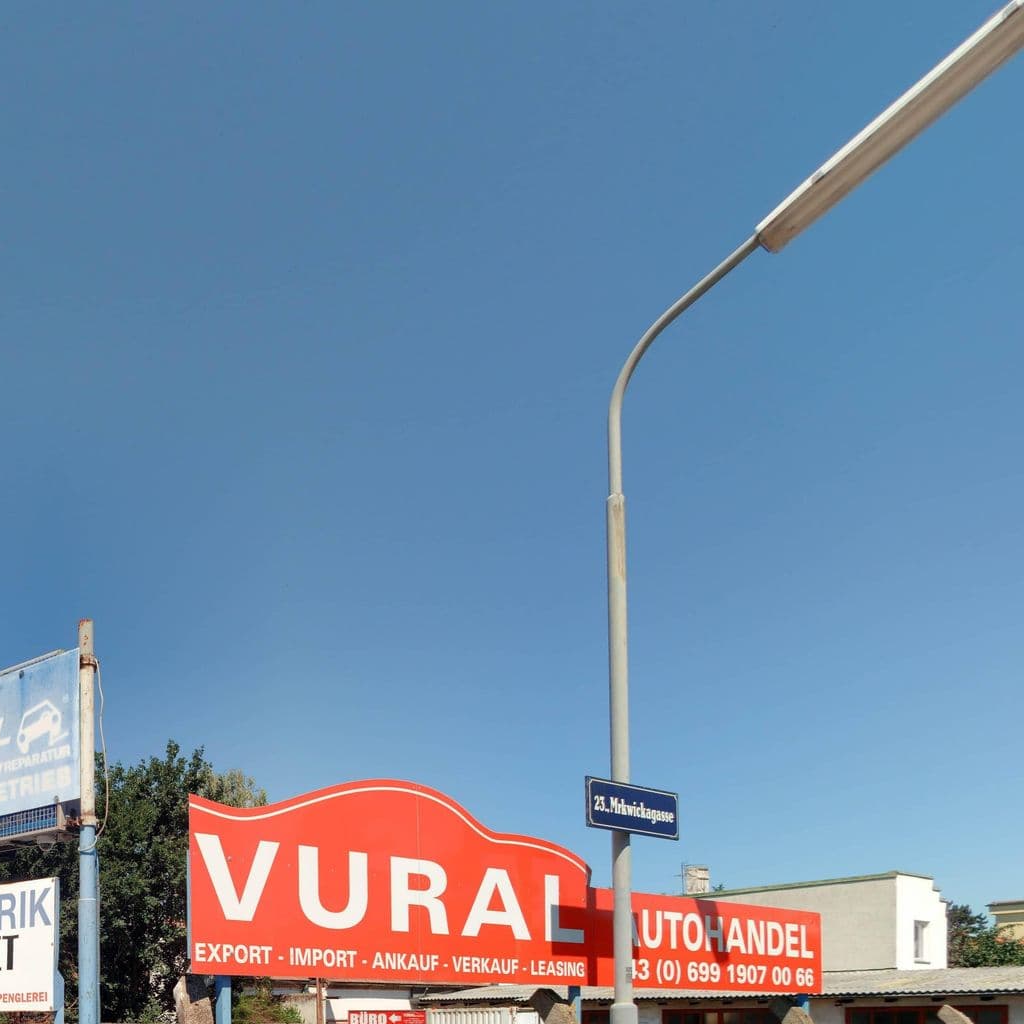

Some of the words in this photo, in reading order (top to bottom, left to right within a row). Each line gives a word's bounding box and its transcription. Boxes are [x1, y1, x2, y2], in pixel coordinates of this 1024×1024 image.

[2, 745, 71, 772] REPARATUR
[610, 797, 674, 825] Mrkwickagasse
[194, 833, 585, 944] VURAL
[195, 942, 272, 964] EXPORT
[289, 946, 357, 969] IMPORT
[372, 952, 439, 972] ANKAUF
[452, 956, 519, 974] VERKAUF
[530, 960, 585, 978] LEASING
[656, 959, 681, 984] (0)
[687, 962, 720, 982] 699
[727, 963, 766, 984] 1907
[772, 966, 791, 986] 00
[795, 967, 814, 987] 66
